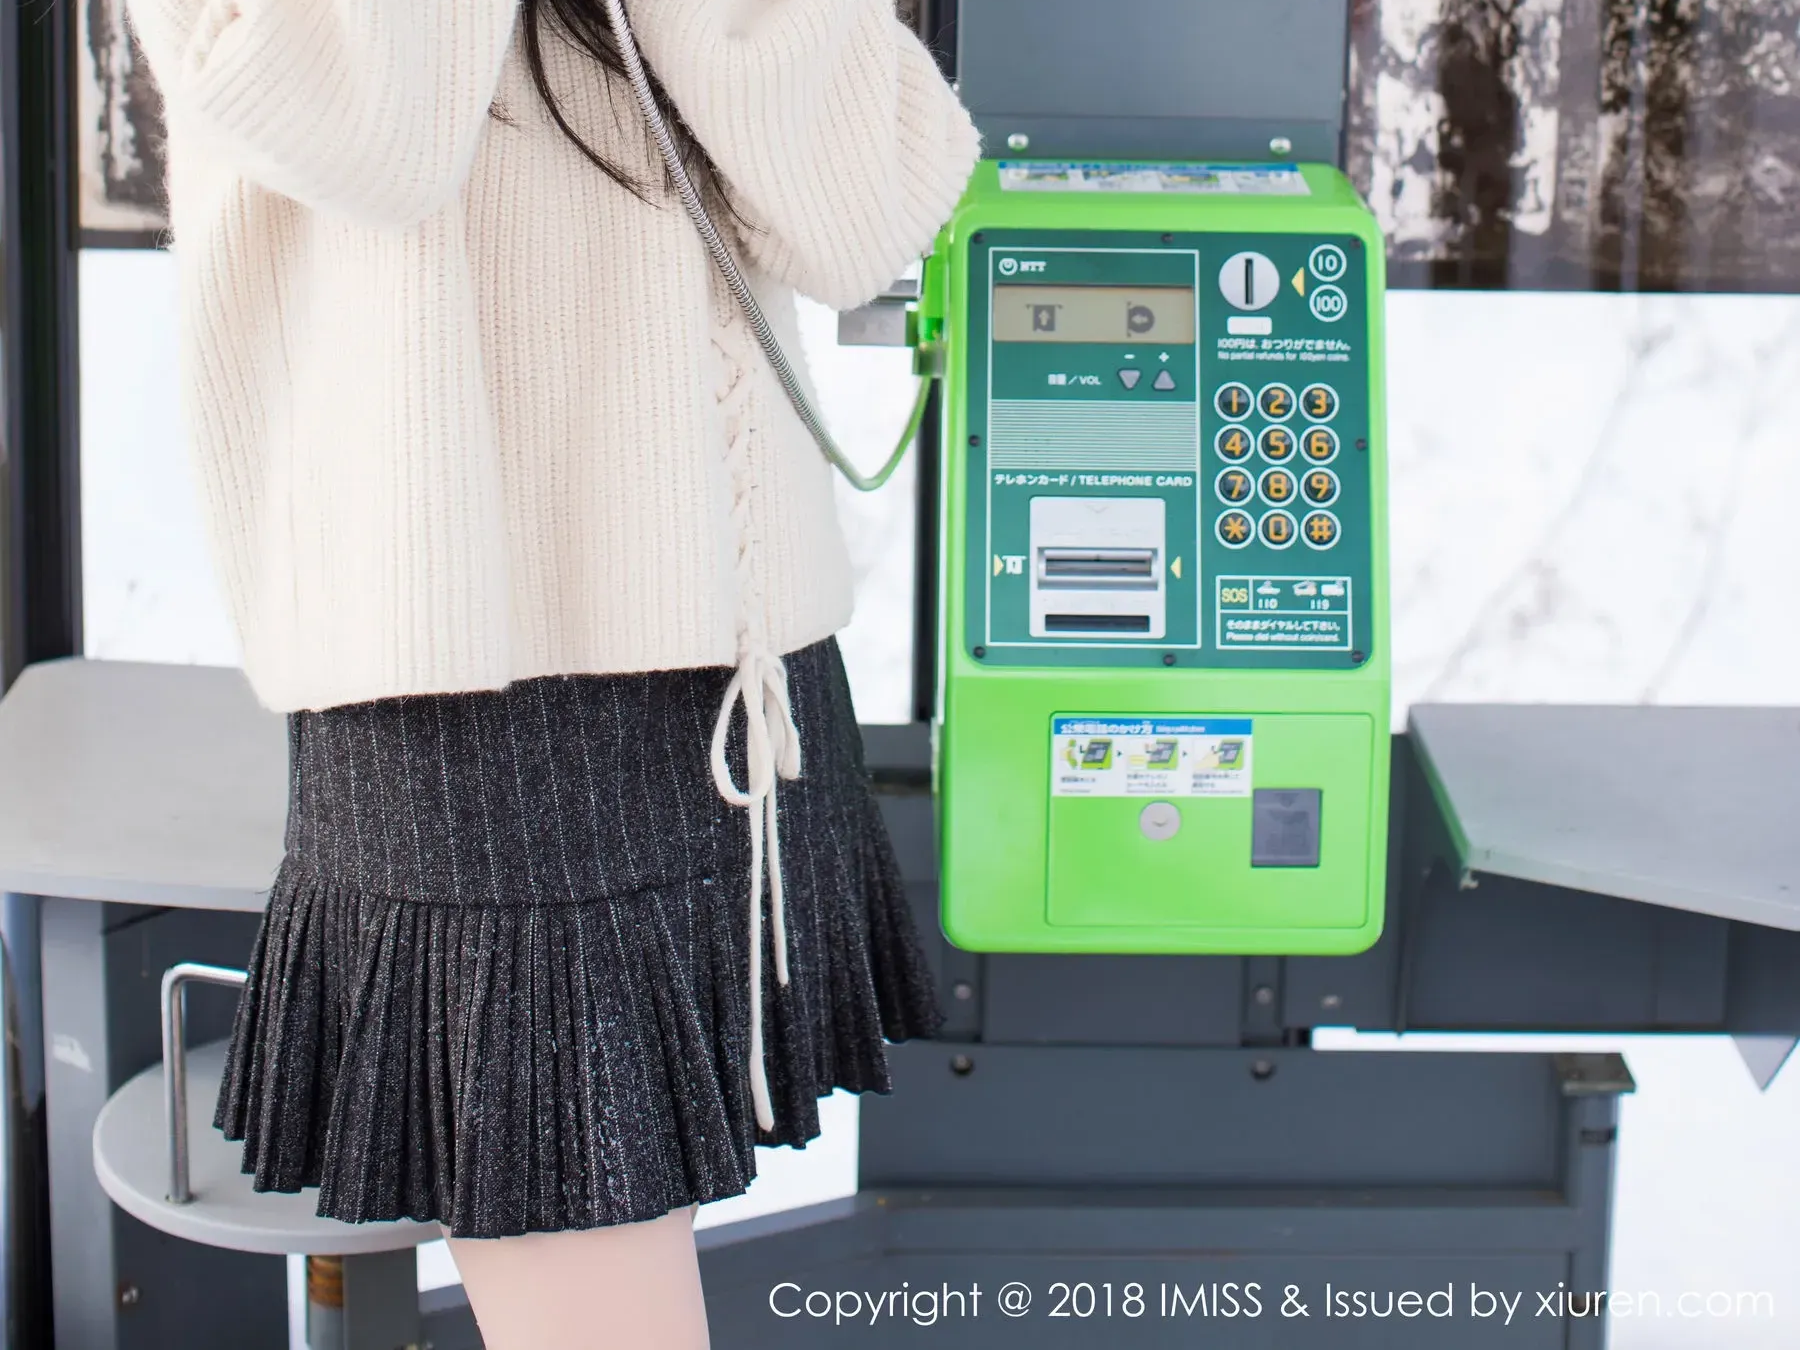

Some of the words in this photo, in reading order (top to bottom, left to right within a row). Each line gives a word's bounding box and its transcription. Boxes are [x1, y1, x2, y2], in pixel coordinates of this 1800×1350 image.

[1317, 253, 1338, 272] 10
[1315, 295, 1342, 313] 100
[1268, 389, 1286, 414] 2
[1311, 389, 1327, 414] 3
[1224, 432, 1242, 456] 4
[1269, 431, 1286, 456] 5
[1311, 432, 1328, 457] 6
[994, 474, 1069, 486] テレホンカード
[1079, 474, 1153, 487] TELEPHONE
[1156, 475, 1193, 487] CARD
[1227, 474, 1245, 499] 7
[1269, 474, 1287, 499] 8
[1311, 474, 1329, 499] 9
[1269, 516, 1287, 540] 0
[1221, 587, 1248, 604] SOS
[1258, 599, 1278, 610] 110
[1310, 599, 1330, 610] 119
